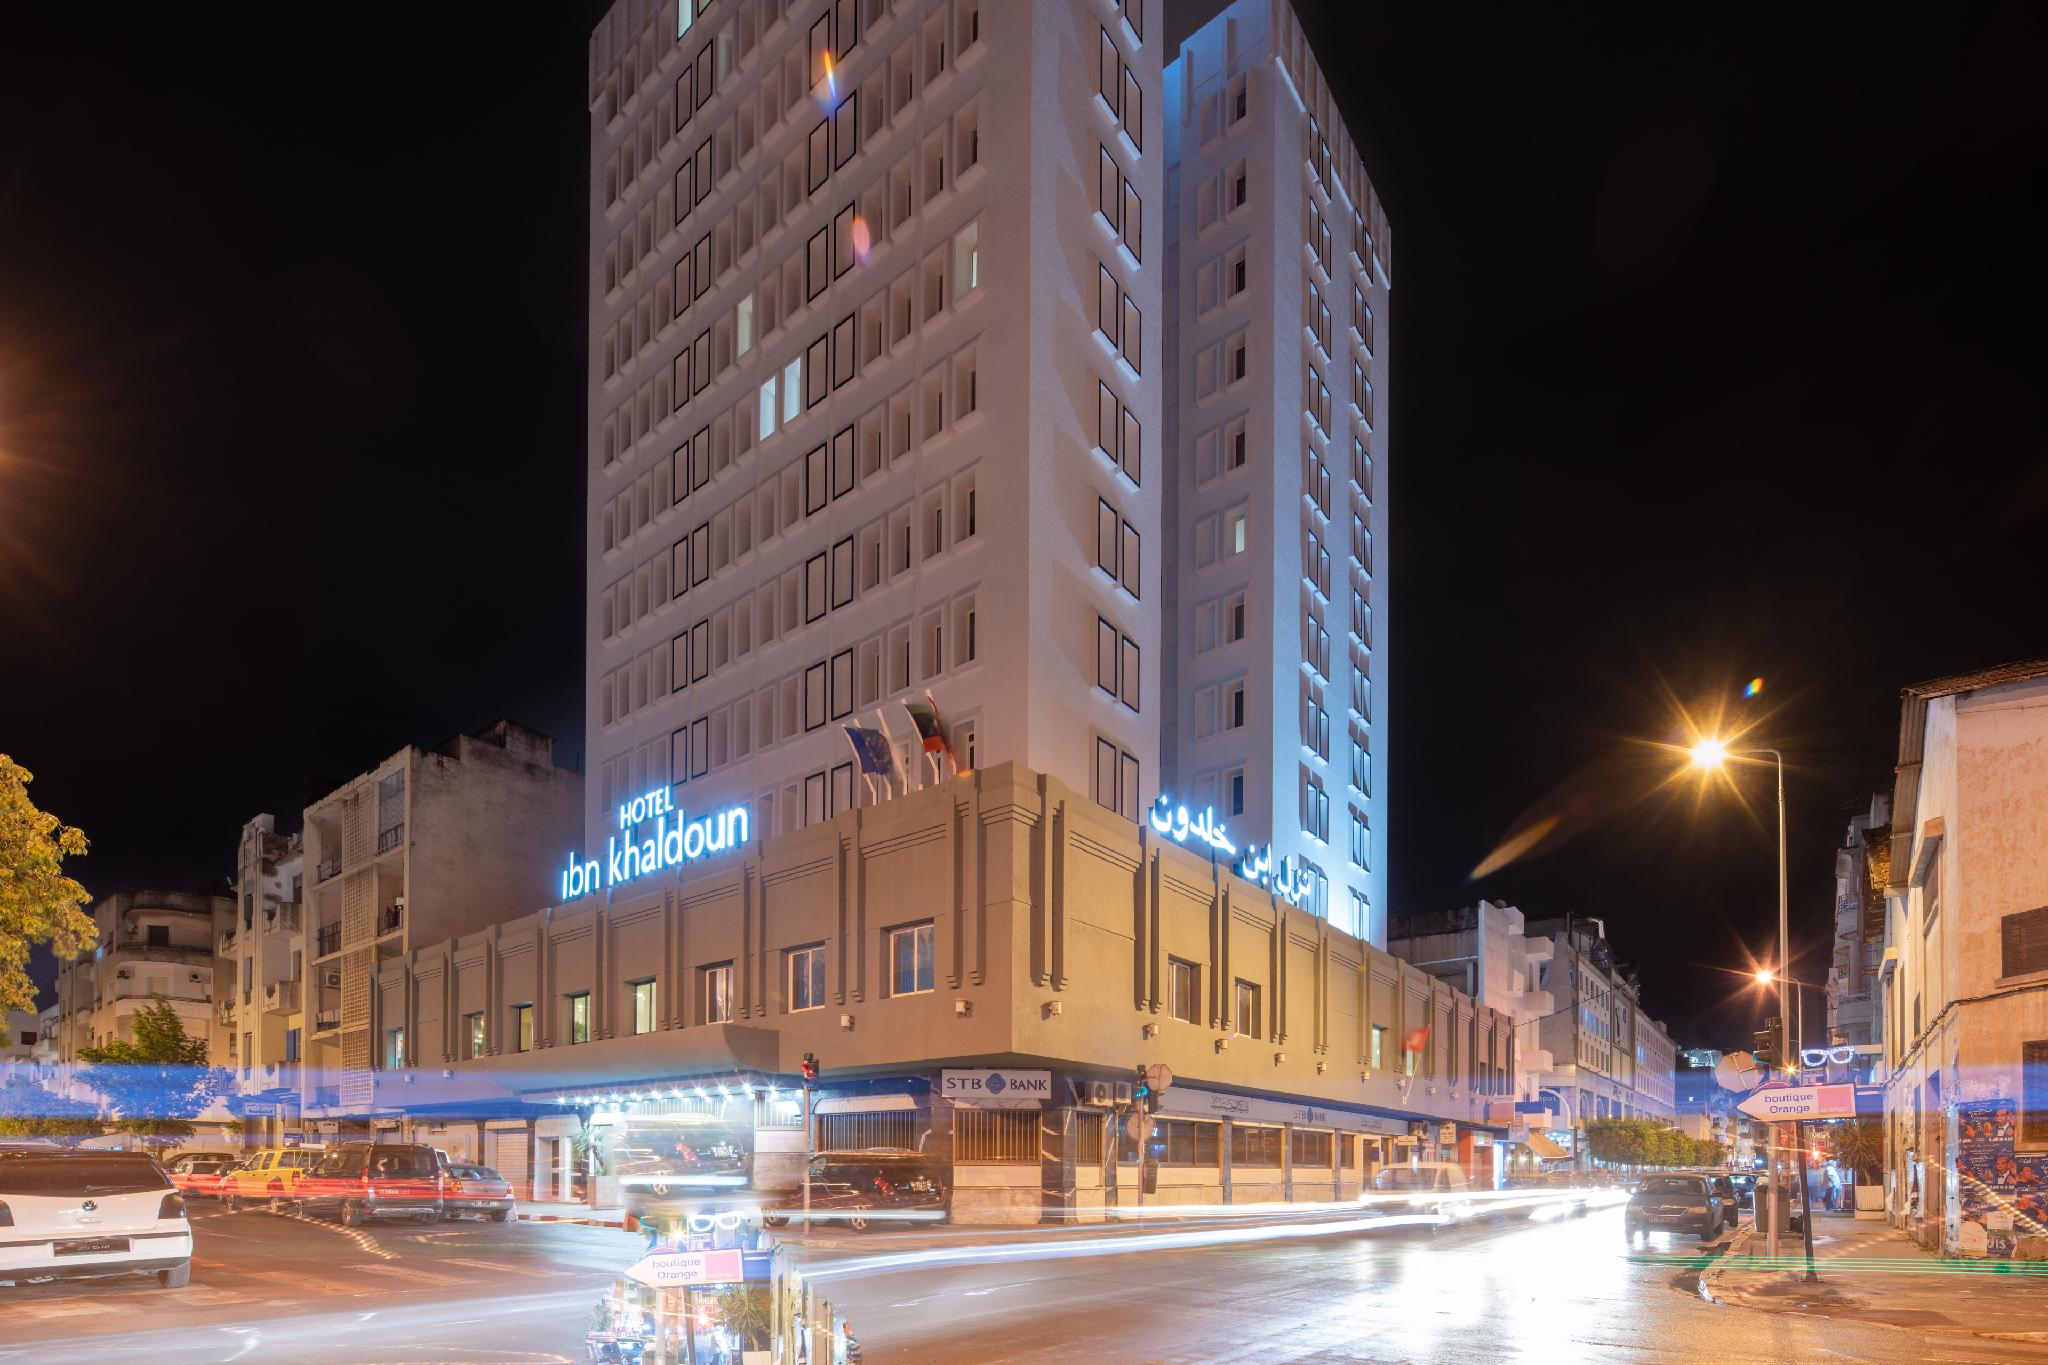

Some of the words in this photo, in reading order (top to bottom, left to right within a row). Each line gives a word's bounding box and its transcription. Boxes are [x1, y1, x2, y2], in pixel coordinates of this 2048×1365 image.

[619, 786, 673, 829] HOTEL
[1152, 794, 1236, 855] خلدون
[608, 807, 749, 886] khaldoun
[1242, 842, 1271, 885] ابن
[1275, 855, 1311, 902] نزل
[946, 1077, 982, 1090] STB
[1010, 1078, 1047, 1091] BANK
[1764, 1093, 1814, 1103] boutique
[1769, 1105, 1810, 1114] Orange
[652, 1259, 701, 1269] boutique
[657, 1271, 698, 1280] Orange
